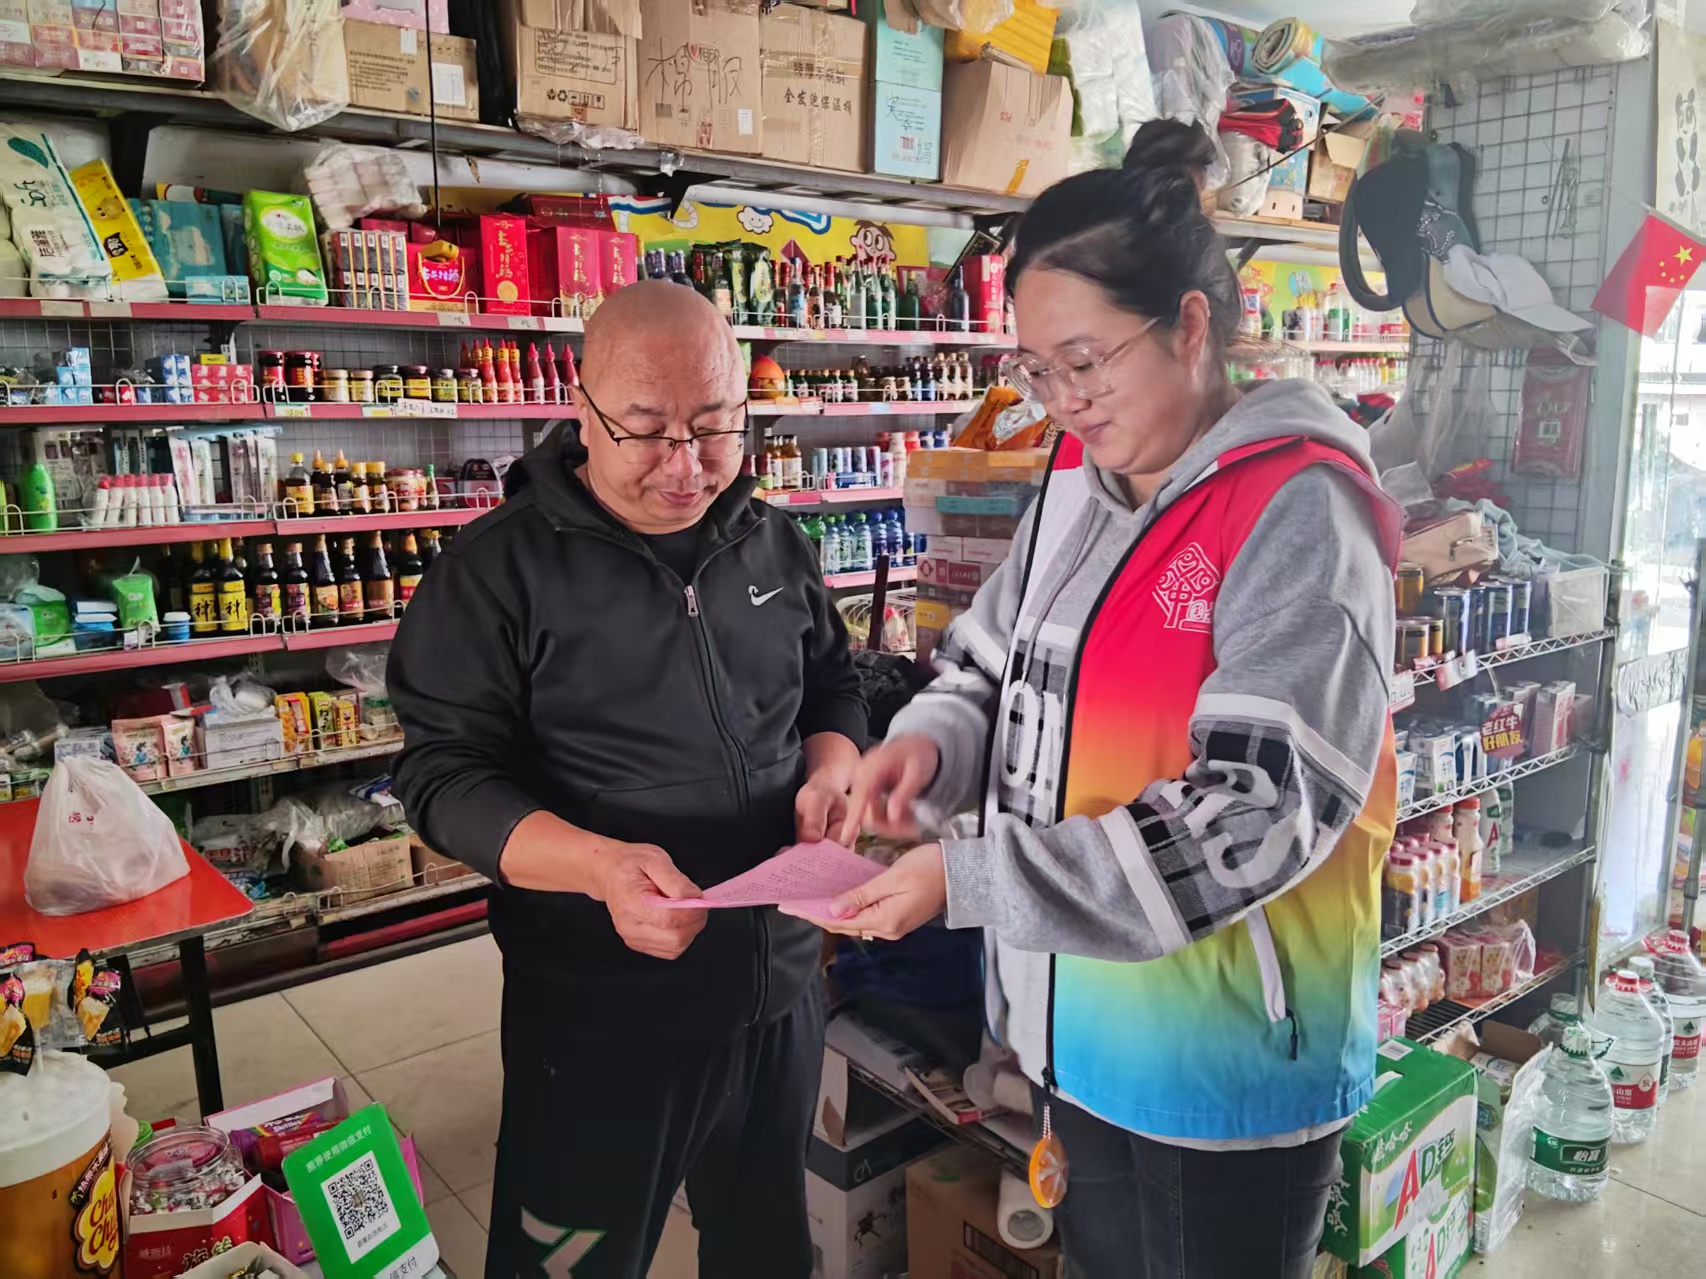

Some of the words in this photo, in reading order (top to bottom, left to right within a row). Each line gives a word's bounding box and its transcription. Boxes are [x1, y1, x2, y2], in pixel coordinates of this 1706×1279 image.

[1482, 715, 1518, 736] 老红牛
[1483, 731, 1523, 751] 好朋友
[305, 1124, 373, 1173] 推荐使用微信支付
